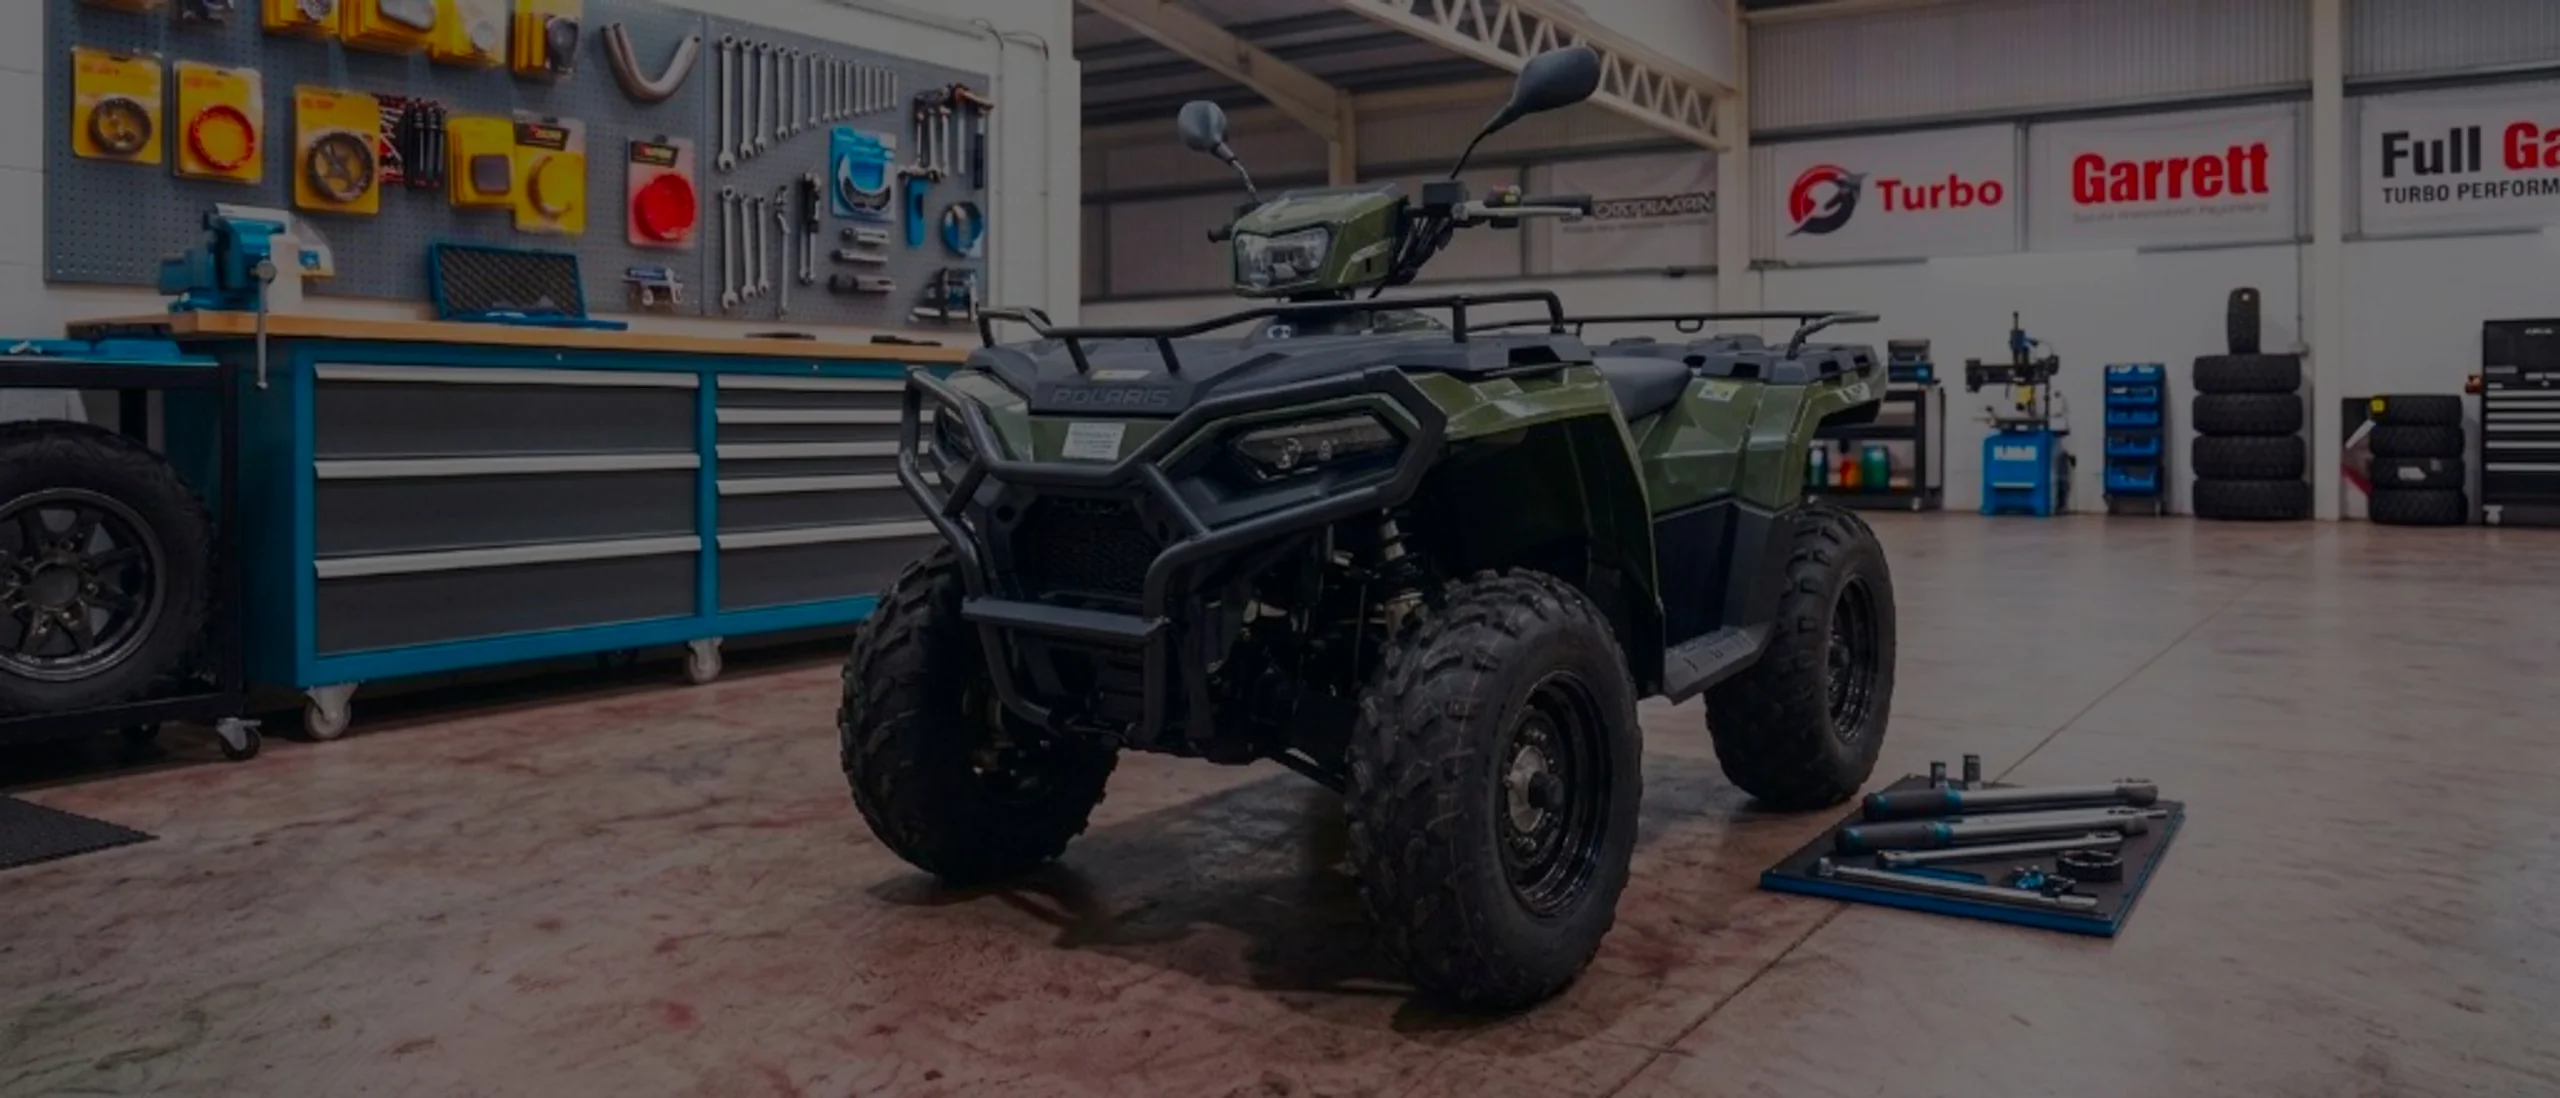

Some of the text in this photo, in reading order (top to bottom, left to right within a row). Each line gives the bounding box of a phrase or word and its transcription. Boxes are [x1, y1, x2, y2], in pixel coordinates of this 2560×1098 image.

[2381, 125, 2482, 179] Full
[1876, 173, 2004, 212] Turbo
[2073, 142, 2269, 205] Garrett
[2382, 184, 2450, 204] TURBO
[1051, 385, 1172, 408] POLARIS
